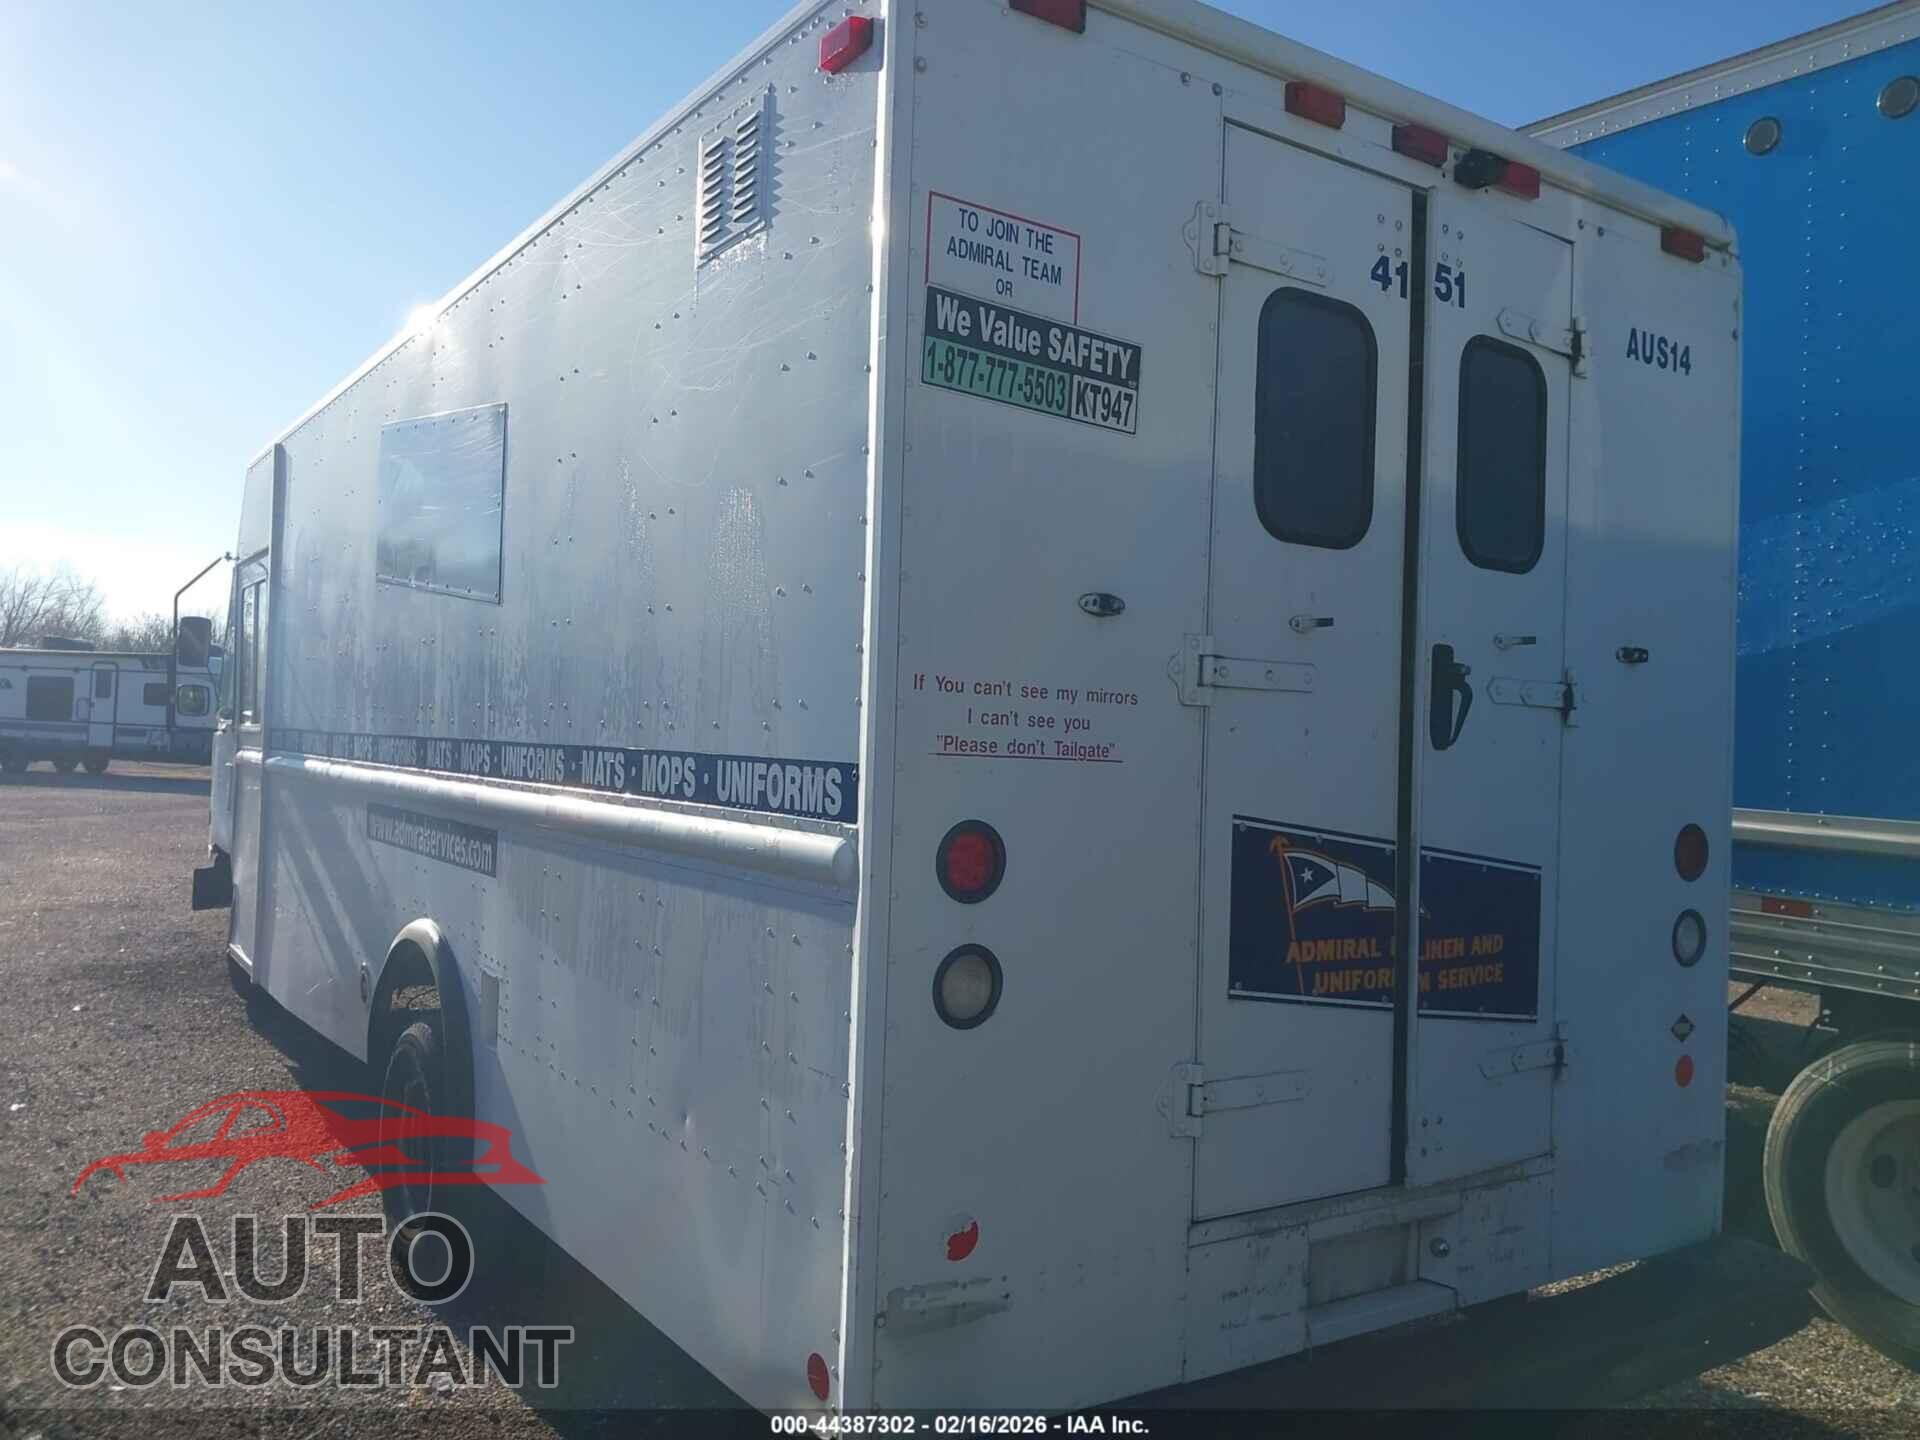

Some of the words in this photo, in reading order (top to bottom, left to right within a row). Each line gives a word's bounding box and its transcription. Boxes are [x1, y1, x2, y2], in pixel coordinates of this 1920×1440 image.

[959, 208, 979, 233] TO
[986, 219, 1019, 244] JOIN
[1026, 228, 1054, 255] THE
[946, 236, 1014, 273] ADMIRAL
[1022, 256, 1063, 286] TEAM
[996, 278, 1014, 298] OR
[936, 294, 972, 337] We
[978, 306, 1041, 356] Value
[1047, 327, 1134, 380] SAFETY
[1626, 327, 1692, 375] AUS14
[926, 340, 1067, 412] 1-877-777-5503
[1074, 379, 1134, 427] KT947
[912, 674, 926, 691] If
[935, 675, 965, 693] You
[973, 680, 1012, 697] can't
[1020, 684, 1049, 700] see
[1056, 687, 1079, 704] my
[1086, 688, 1139, 706] mirrors
[967, 708, 973, 724] I
[980, 710, 1019, 728] can't
[1027, 713, 1056, 729] see
[1063, 716, 1091, 734] you
[936, 735, 998, 754] "Please
[1006, 738, 1046, 756] don't
[1054, 740, 1116, 761] Tailgate"
[426, 739, 453, 769] MATS
[460, 741, 491, 774] MOPS
[501, 744, 565, 783] UNIFORMS
[581, 749, 625, 789] MATS
[641, 754, 697, 798] MOPS
[716, 759, 843, 816] UNIFORMS
[1284, 937, 1382, 964] ADMIRAL
[1470, 933, 1505, 956] AND
[1437, 963, 1505, 990] SERVICE
